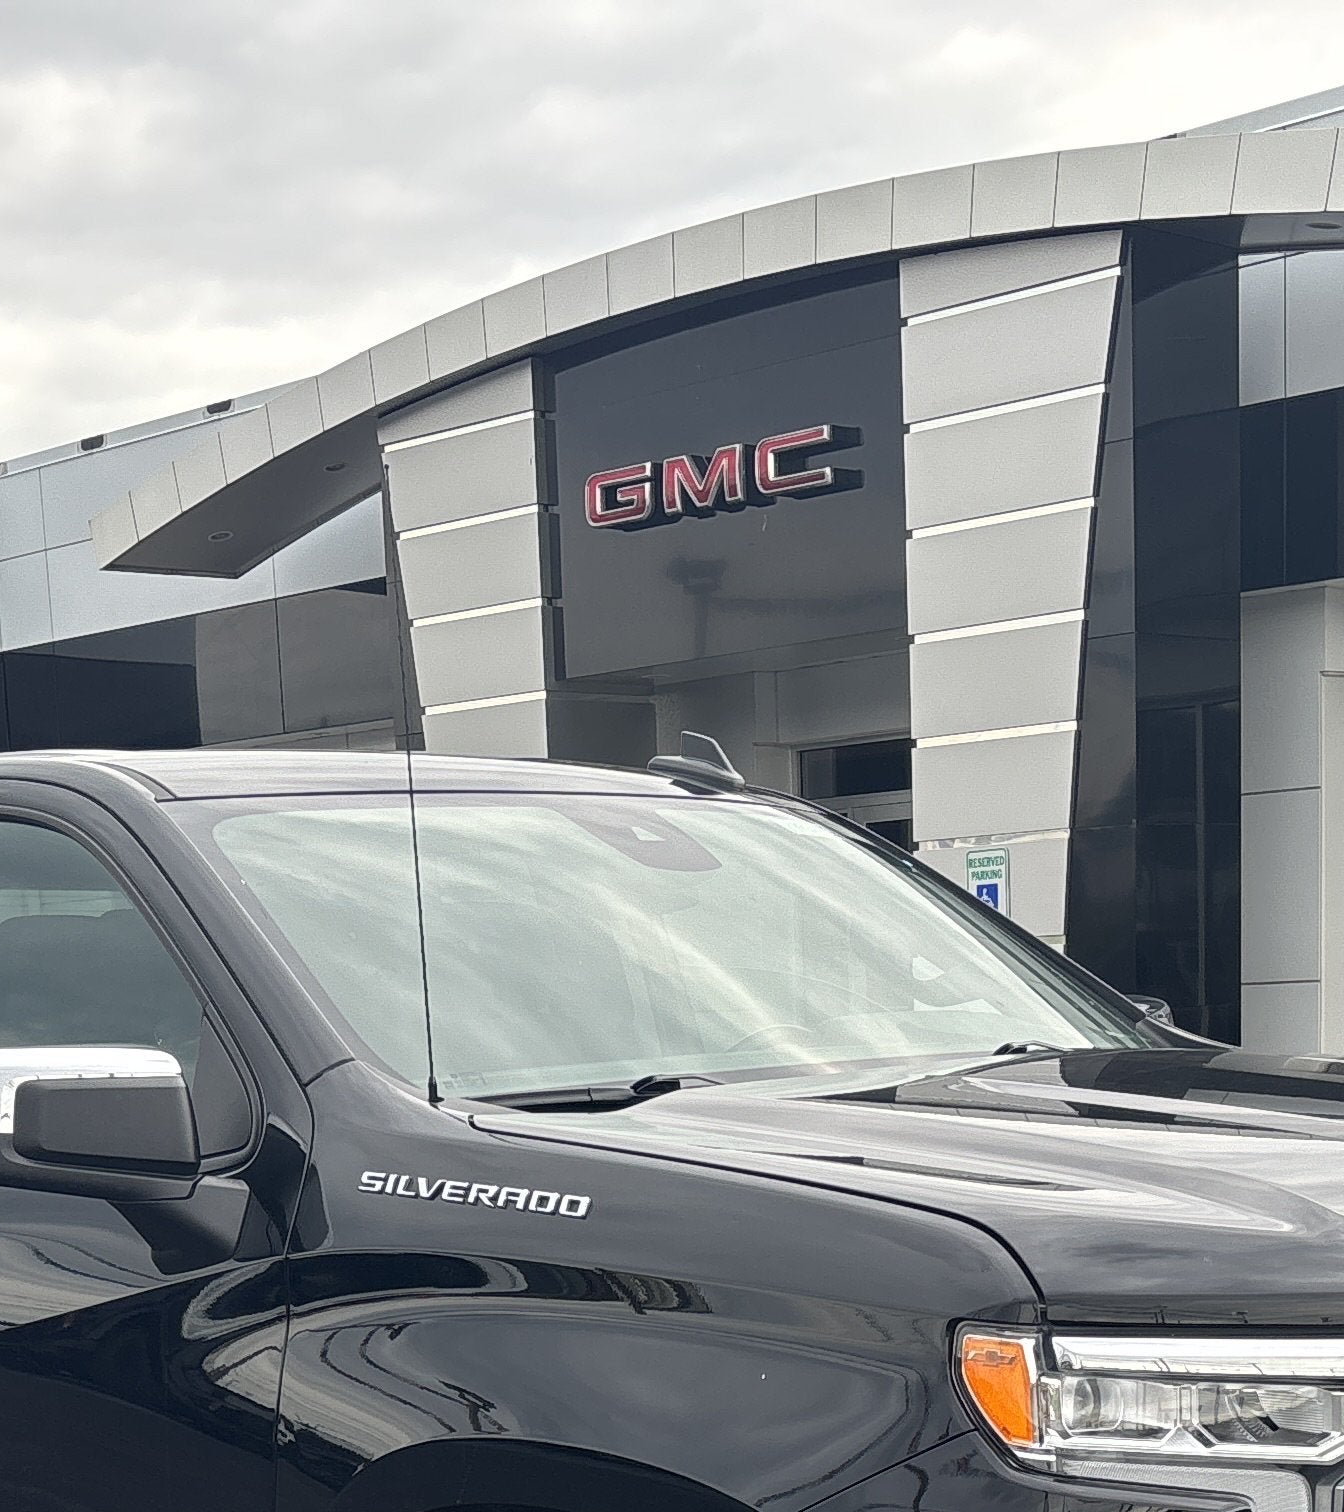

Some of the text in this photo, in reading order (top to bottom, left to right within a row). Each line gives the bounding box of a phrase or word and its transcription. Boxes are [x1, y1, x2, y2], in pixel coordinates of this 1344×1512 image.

[585, 424, 832, 527] GMC
[969, 856, 1004, 868] RESERVED
[971, 869, 1002, 881] PARKING
[358, 1171, 592, 1218] SILVERADO
